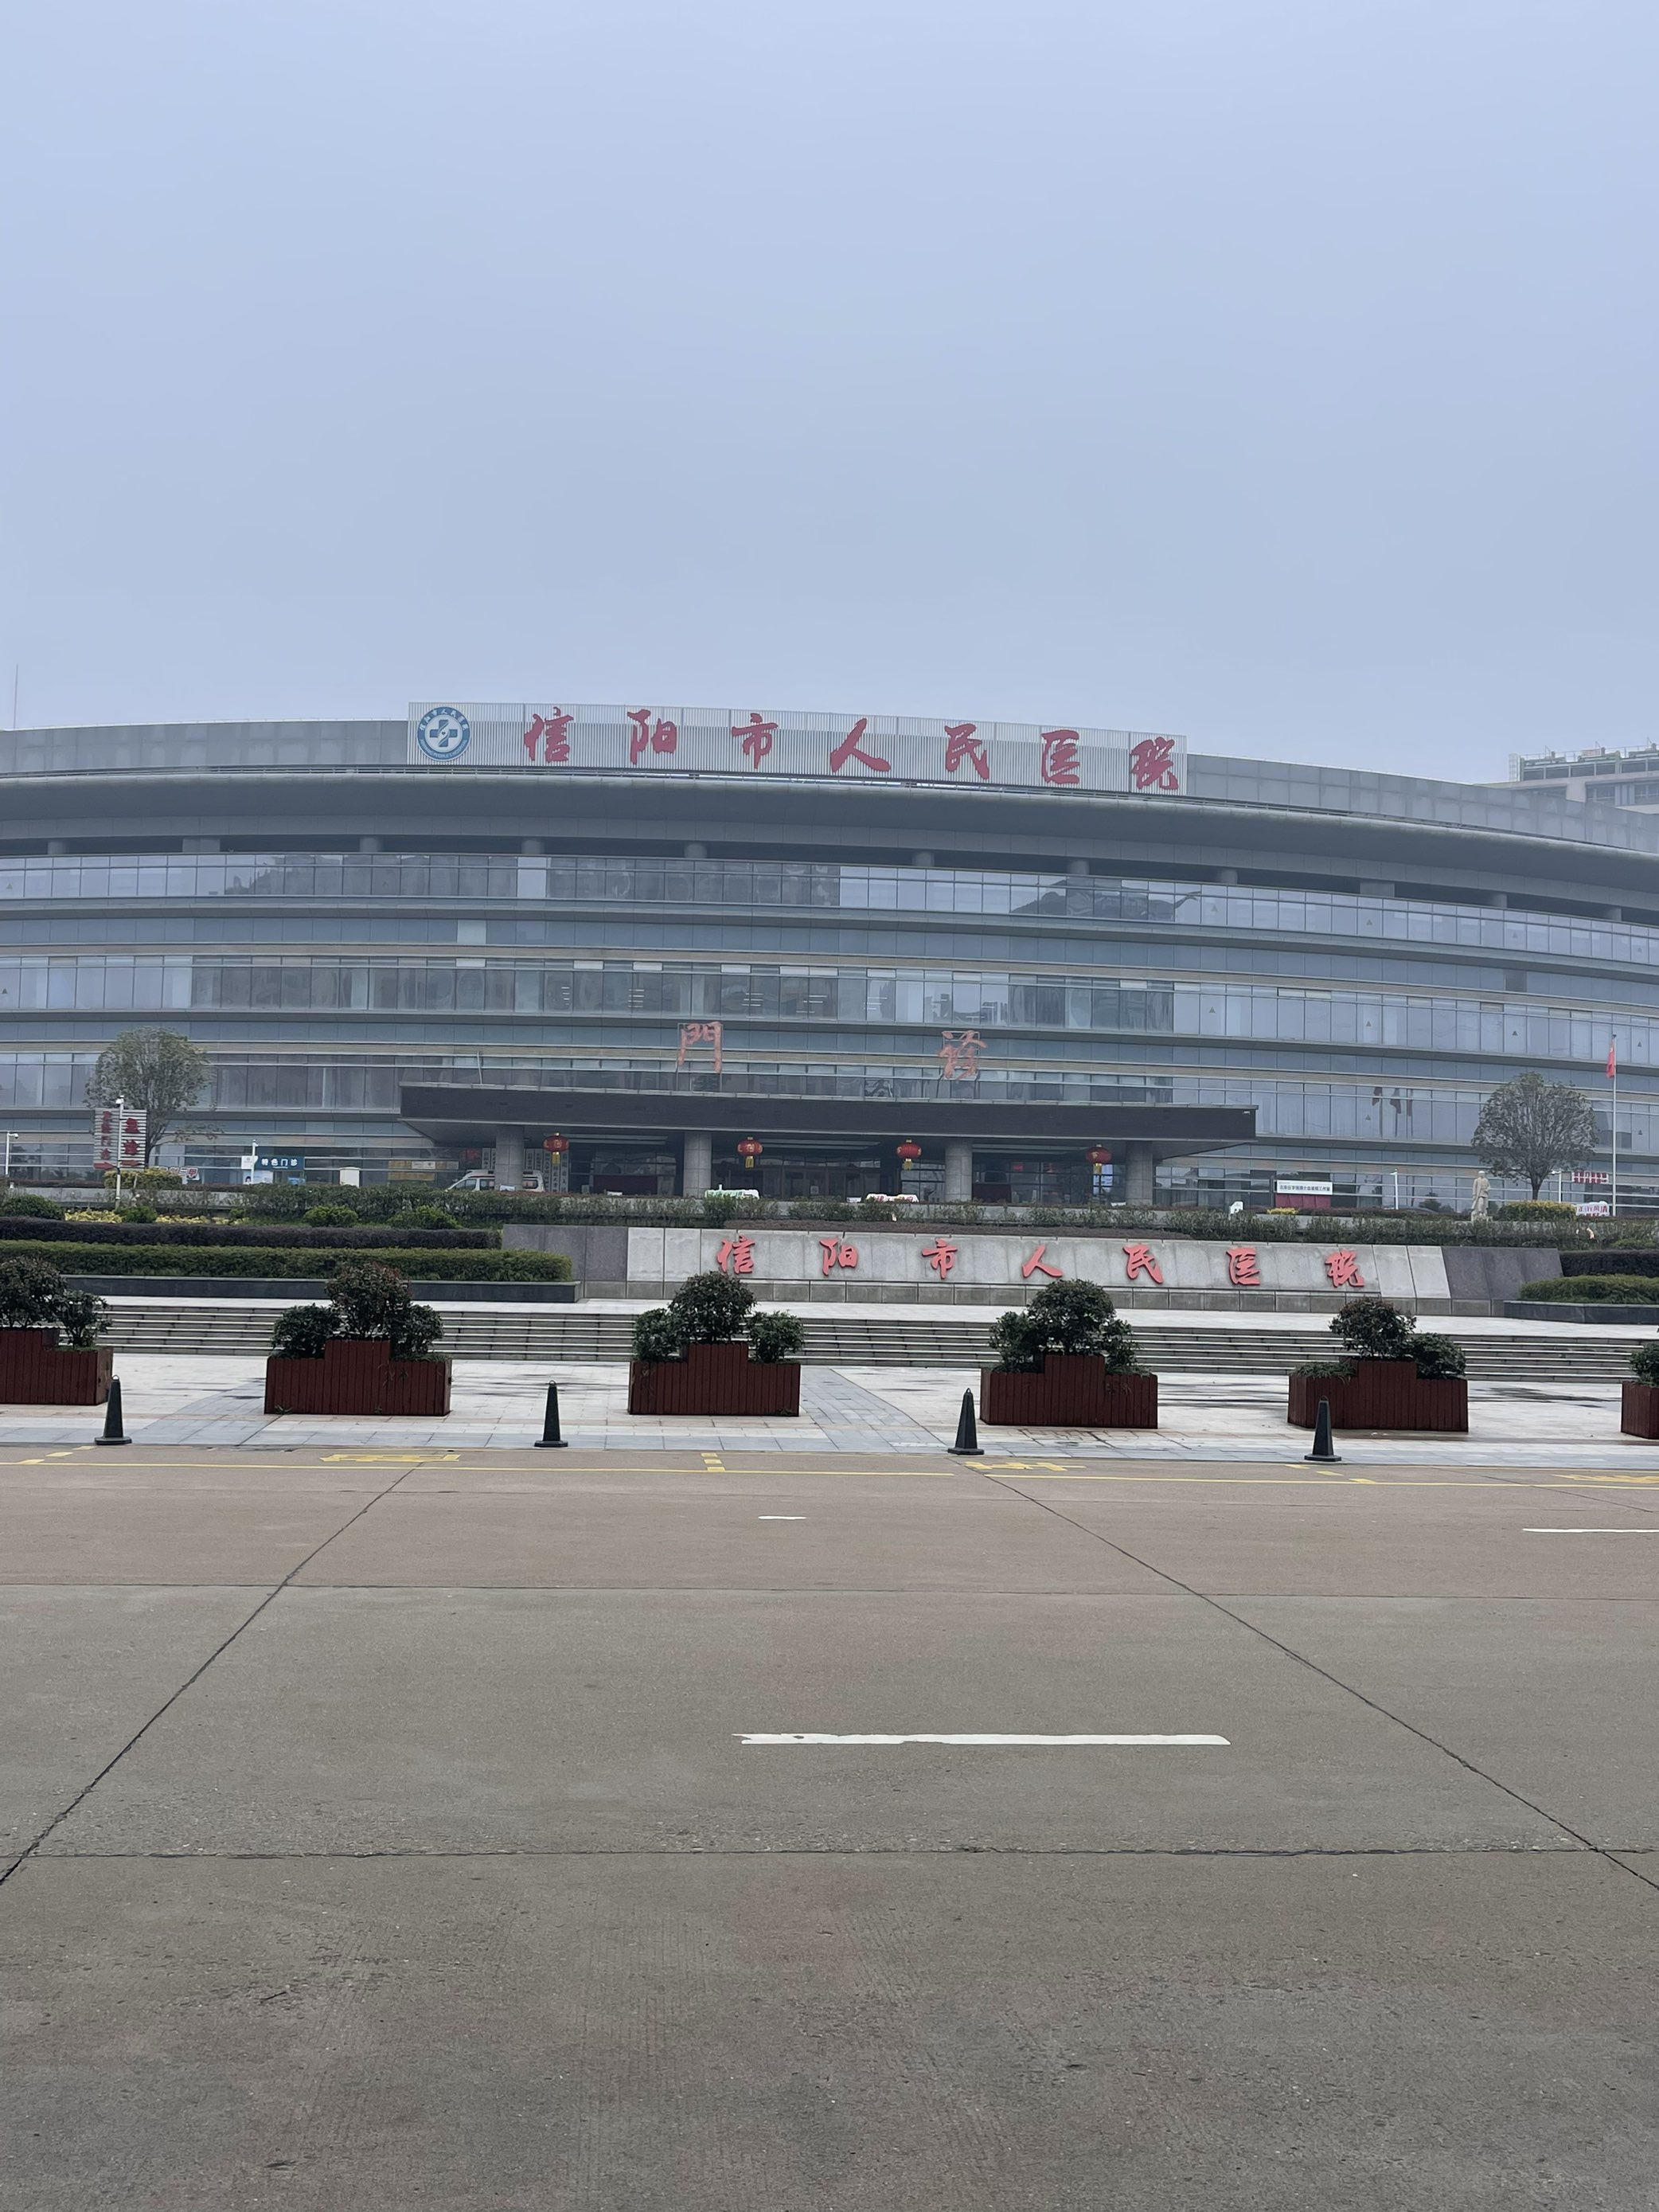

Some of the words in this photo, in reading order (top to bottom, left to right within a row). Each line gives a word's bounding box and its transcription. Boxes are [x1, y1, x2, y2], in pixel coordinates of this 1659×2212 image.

[524, 706, 1179, 790] 信阳市人民医院
[261, 1158, 298, 1167] 特色门诊
[717, 1235, 1364, 1288] 信阳市人民医院
